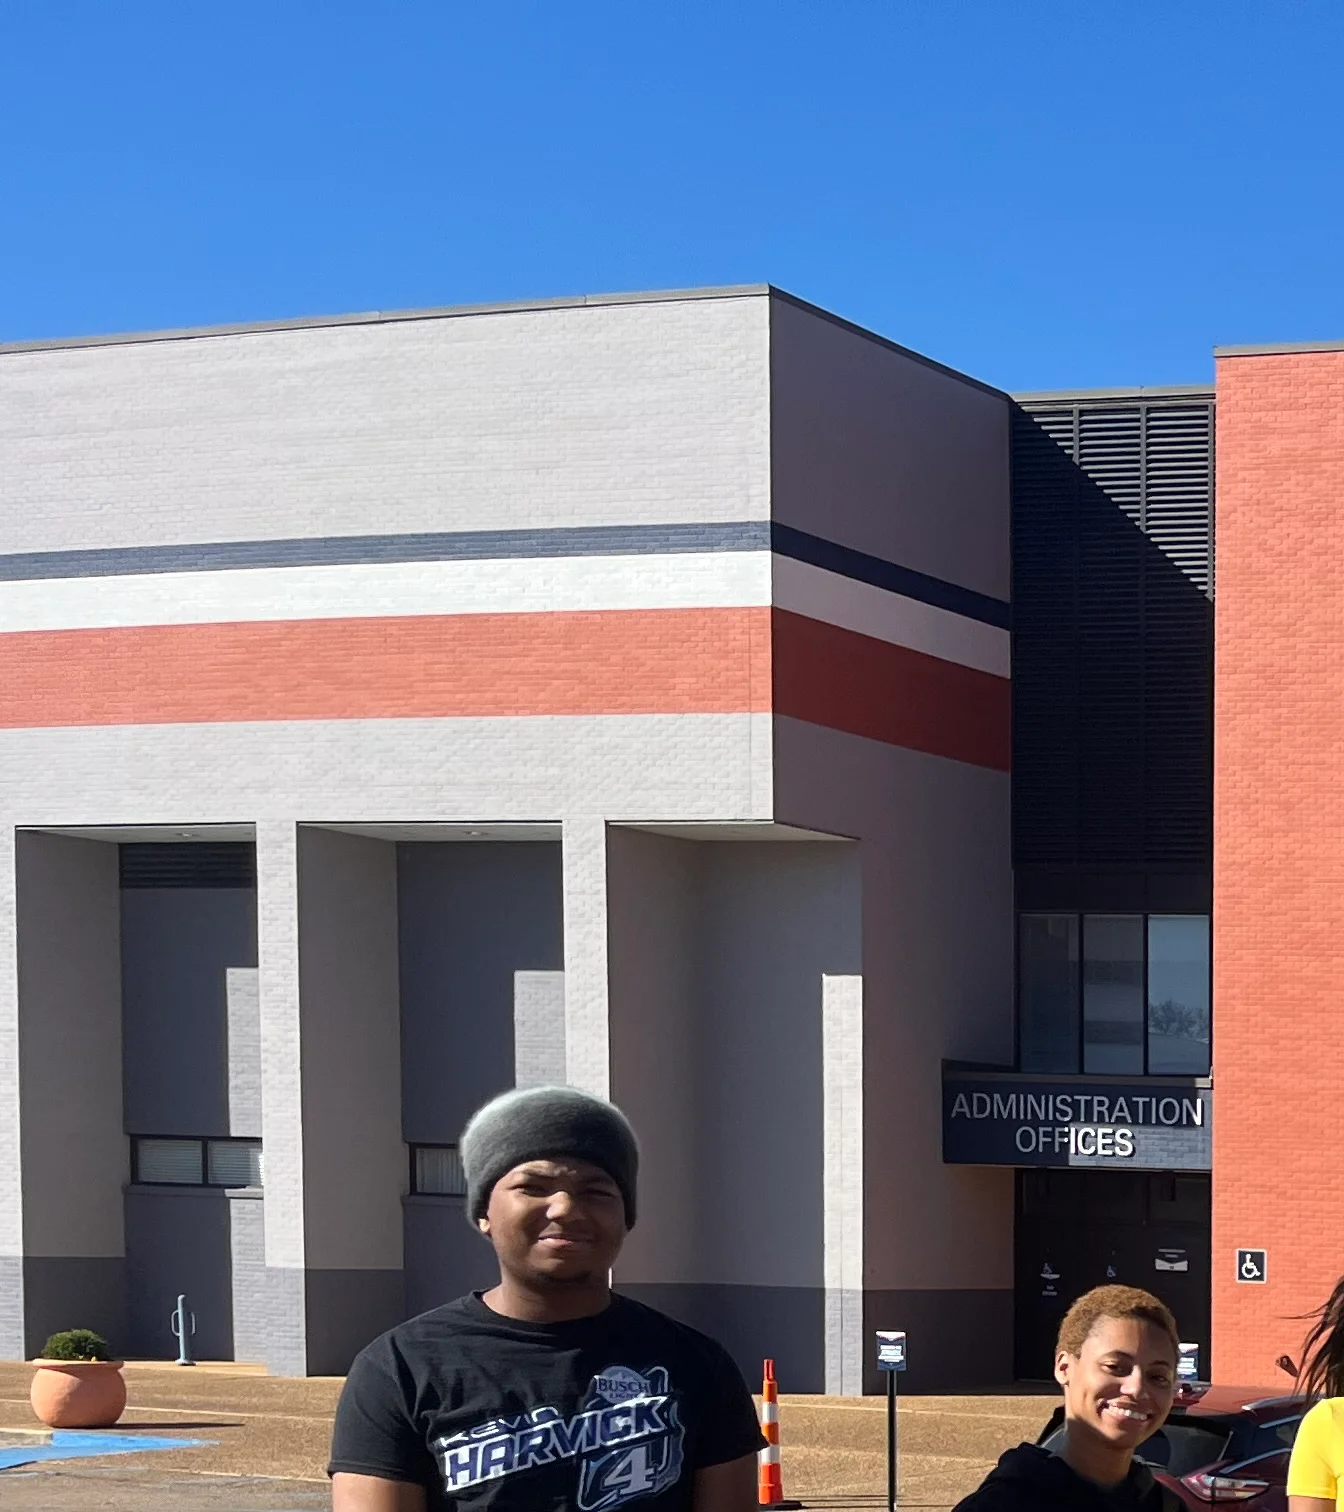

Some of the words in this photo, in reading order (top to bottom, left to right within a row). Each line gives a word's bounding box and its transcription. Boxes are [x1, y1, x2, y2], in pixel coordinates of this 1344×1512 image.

[951, 1091, 1203, 1126] ADMINISTRATION
[1015, 1125, 1135, 1157] OFFICES
[598, 1377, 650, 1394] BUSCH
[444, 1396, 671, 1491] HARVICK
[602, 1445, 656, 1496] 4
